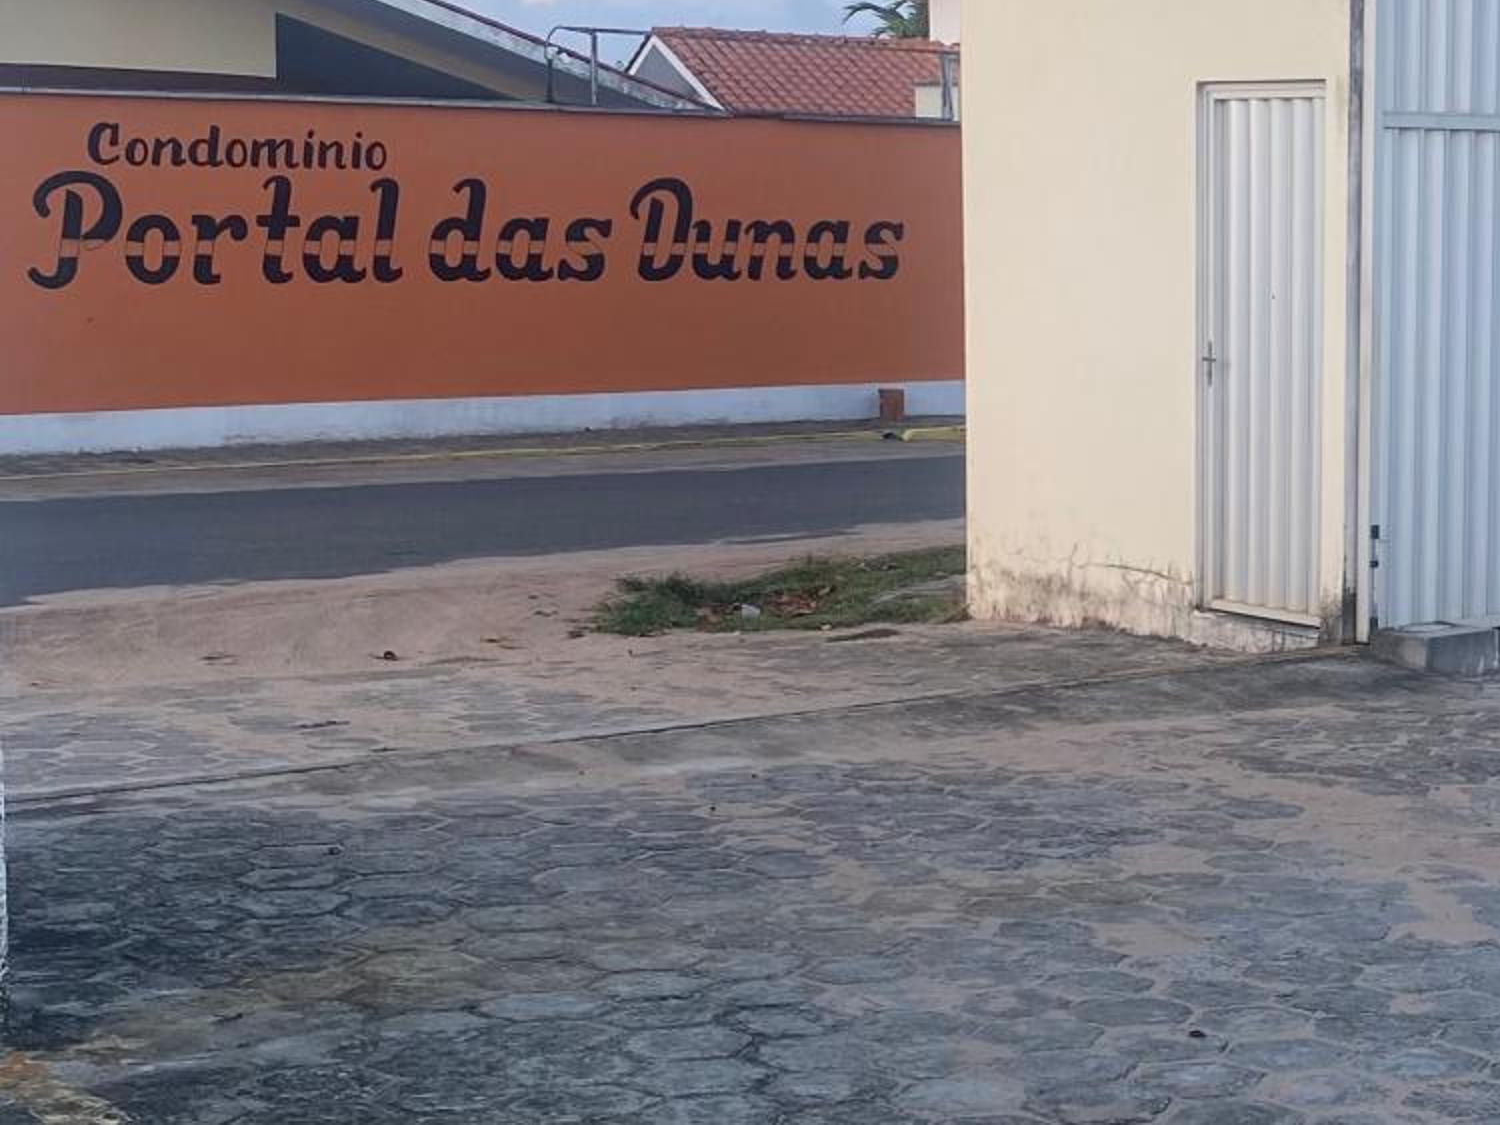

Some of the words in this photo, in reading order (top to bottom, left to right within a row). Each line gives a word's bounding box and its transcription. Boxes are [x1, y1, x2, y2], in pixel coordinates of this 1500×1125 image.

[27, 170, 404, 290] Portal
[428, 178, 613, 282] das
[629, 177, 905, 282] Dunas
